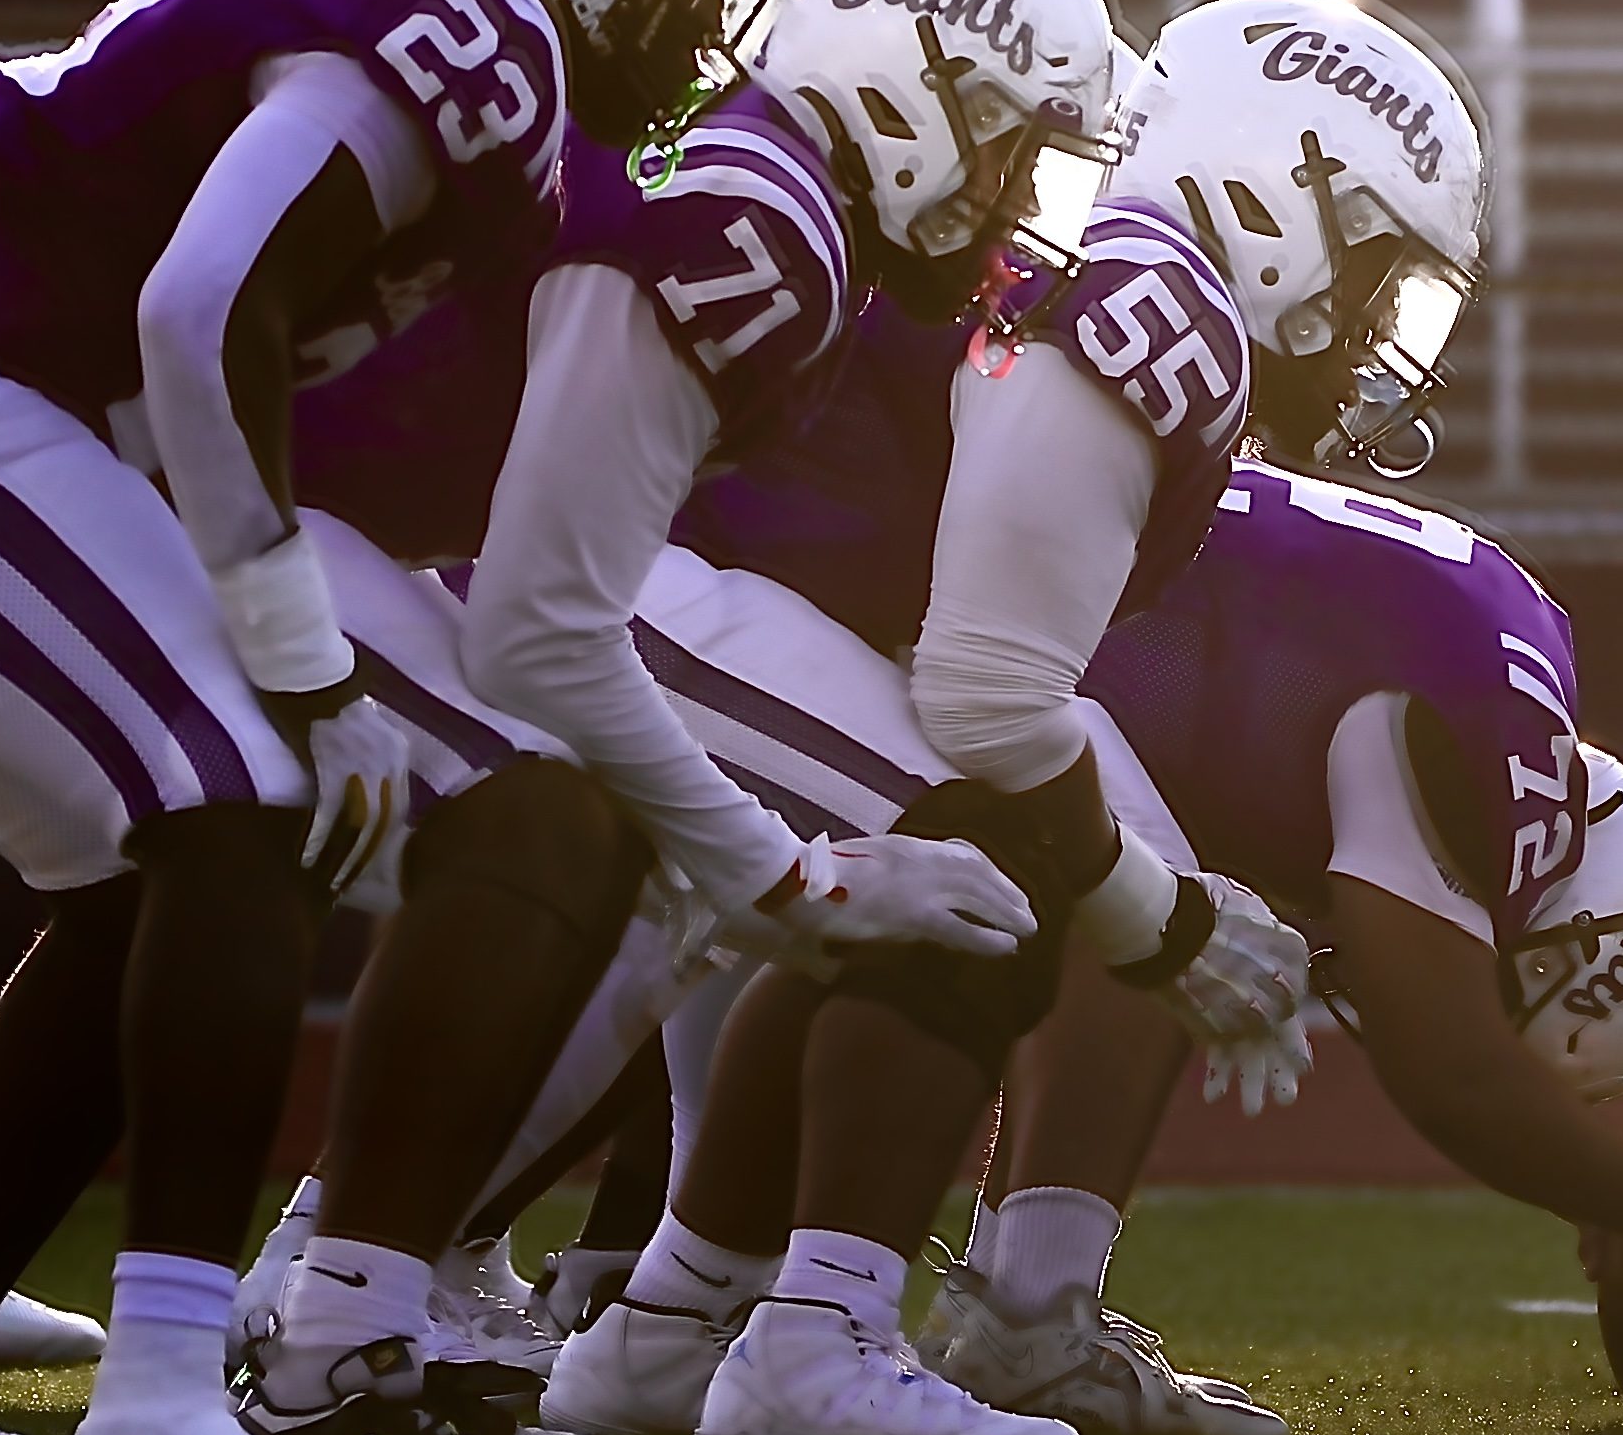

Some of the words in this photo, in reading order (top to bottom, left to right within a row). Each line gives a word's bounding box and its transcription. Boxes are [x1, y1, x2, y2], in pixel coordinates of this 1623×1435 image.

[1262, 30, 1444, 185] Giants
[656, 216, 801, 374] 71
[1076, 269, 1230, 437] 55
[1507, 734, 1575, 896] 72
